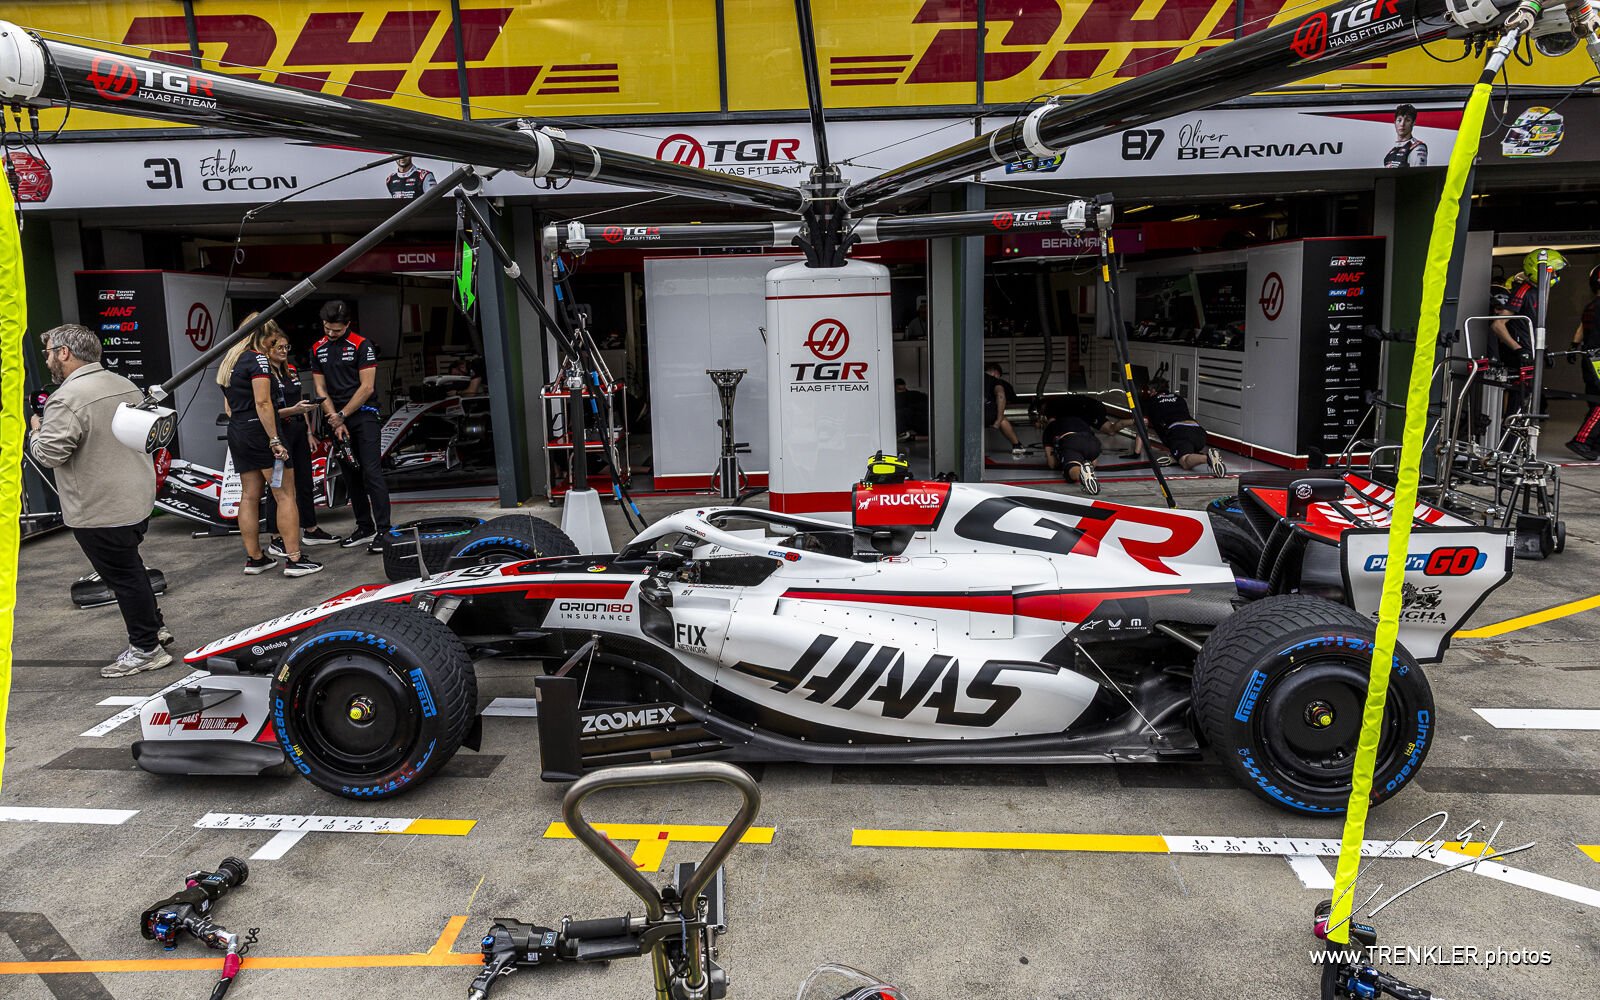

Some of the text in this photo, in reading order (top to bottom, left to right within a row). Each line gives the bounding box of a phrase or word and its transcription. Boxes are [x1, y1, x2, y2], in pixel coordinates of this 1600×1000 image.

[1328, 32, 1359, 48] HAAS
[1370, 18, 1404, 34] TEAM
[135, 66, 215, 97] TGR
[138, 90, 171, 103] HAAS
[186, 98, 217, 110] TEAM
[1178, 119, 1229, 148] Oliver
[707, 138, 800, 163] TGR
[1121, 128, 1344, 161] 87 BEARMAN
[199, 148, 254, 177] Esteban
[763, 165, 802, 175] TEAM
[143, 157, 298, 192] 31 OCON
[1013, 211, 1052, 222] TGR
[622, 226, 660, 236] TGR
[397, 252, 436, 264] OCON
[1329, 271, 1367, 283] HAAS
[1347, 287, 1361, 297] GO
[99, 306, 137, 317] HAAS
[120, 321, 135, 332] GO
[790, 362, 869, 381] TGR
[790, 384, 822, 393] HAAS
[837, 384, 869, 392] TEAM
[879, 493, 940, 507] RUCKUS
[954, 495, 1205, 577] GR
[785, 551, 800, 562] GO
[1425, 547, 1478, 575] GO
[559, 602, 633, 613] ORION180
[560, 613, 631, 622] INSURANCE
[676, 622, 707, 647] FIX
[262, 641, 288, 652] infobip
[677, 643, 709, 655] NETWORK
[731, 633, 1062, 728] HAAS
[409, 667, 438, 718] PIRELLI
[1234, 669, 1268, 723] PIRELLI
[581, 706, 677, 734] ZOOMEX
[1192, 844, 1209, 852] 30
